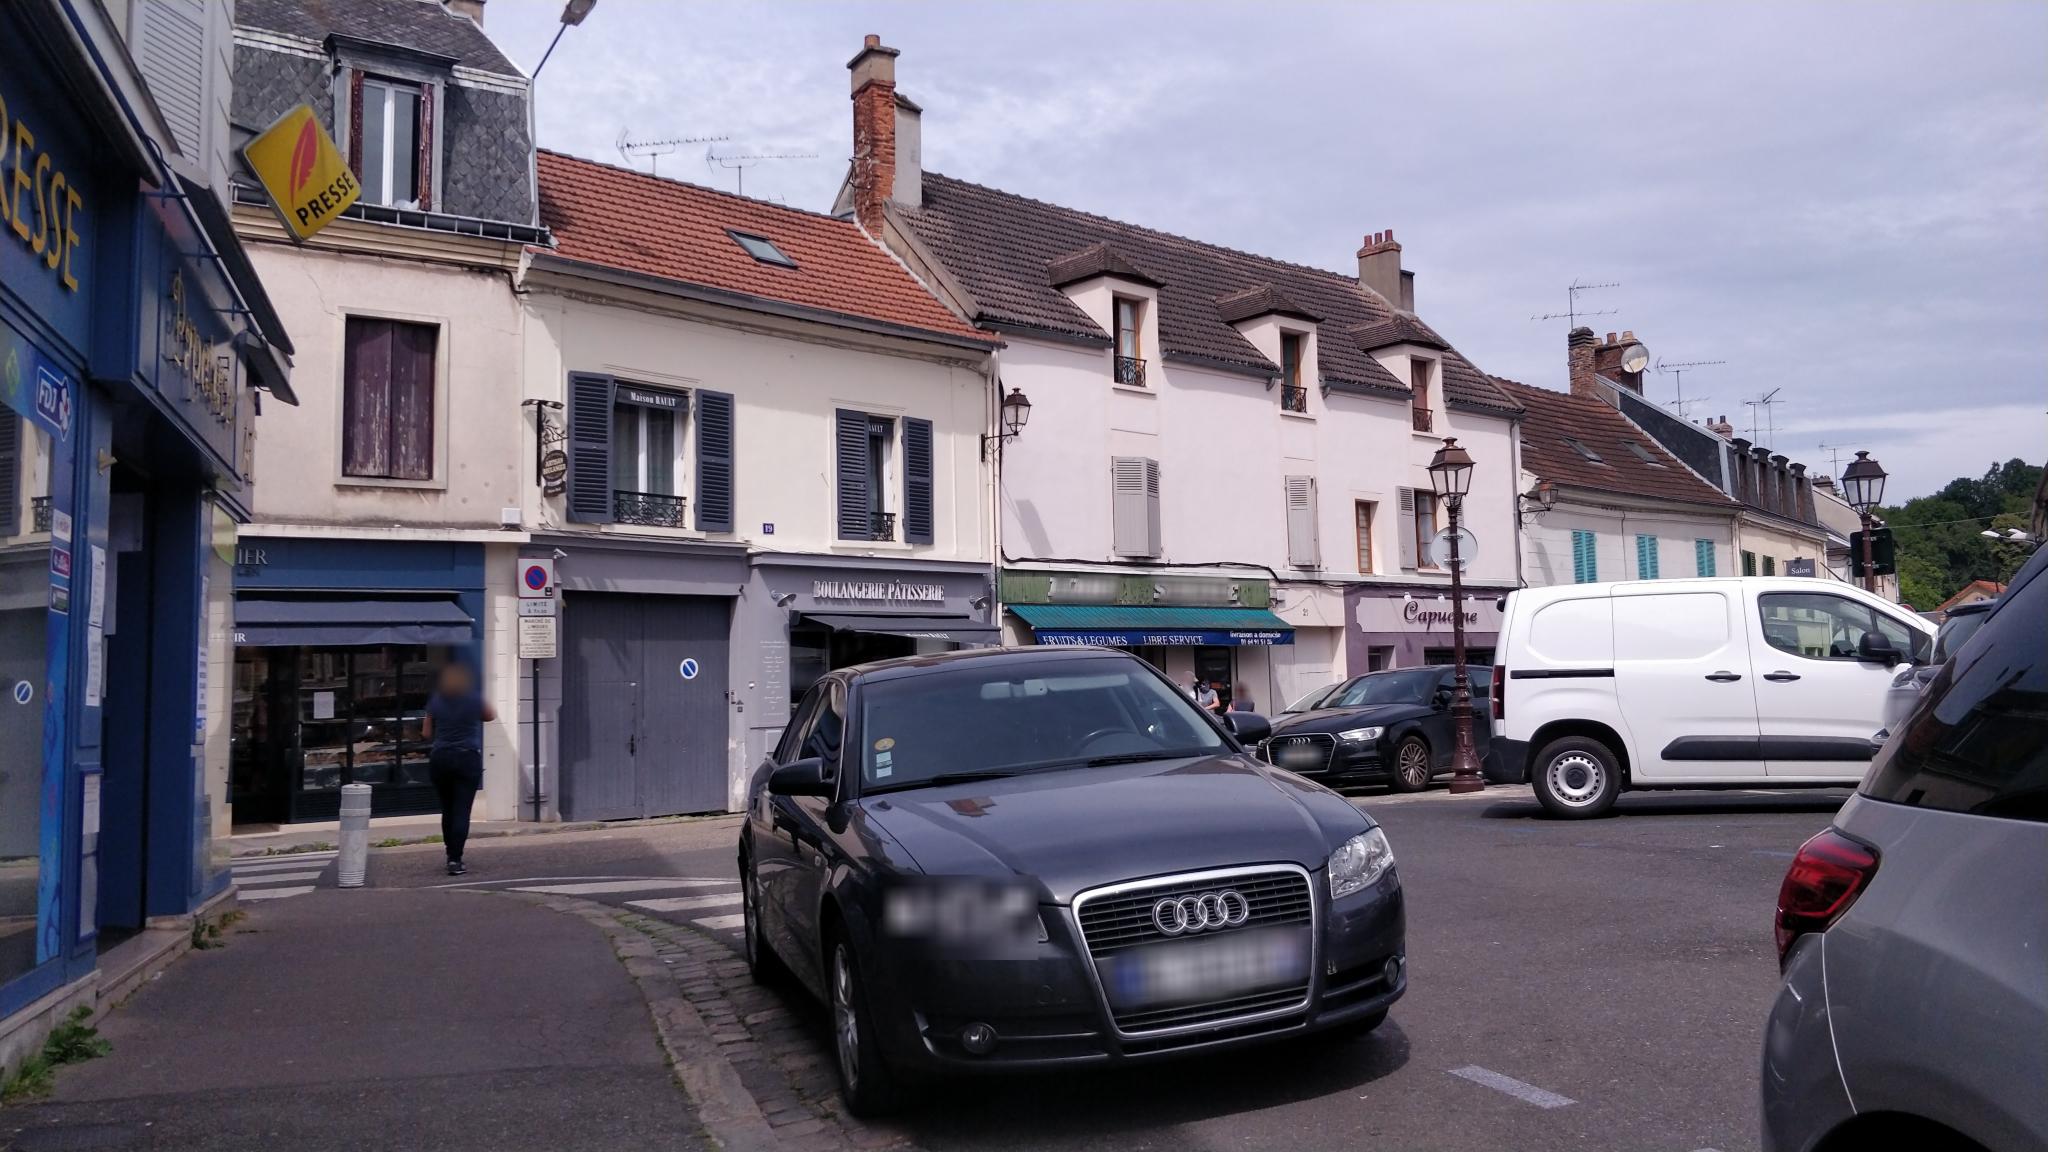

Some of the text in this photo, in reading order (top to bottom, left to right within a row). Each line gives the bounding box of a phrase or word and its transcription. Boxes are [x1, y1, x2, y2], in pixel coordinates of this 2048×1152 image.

[296, 171, 354, 227] PRESSE
[39, 377, 58, 414] FDJ
[630, 391, 654, 404] Maison
[764, 524, 774, 533] 19
[1791, 567, 1811, 575] Salon
[812, 578, 945, 601] BOULANGERIE PÂTISSERIE
[1404, 600, 1478, 632] Capucne
[1143, 635, 1204, 646] LIBRE SERVICE
